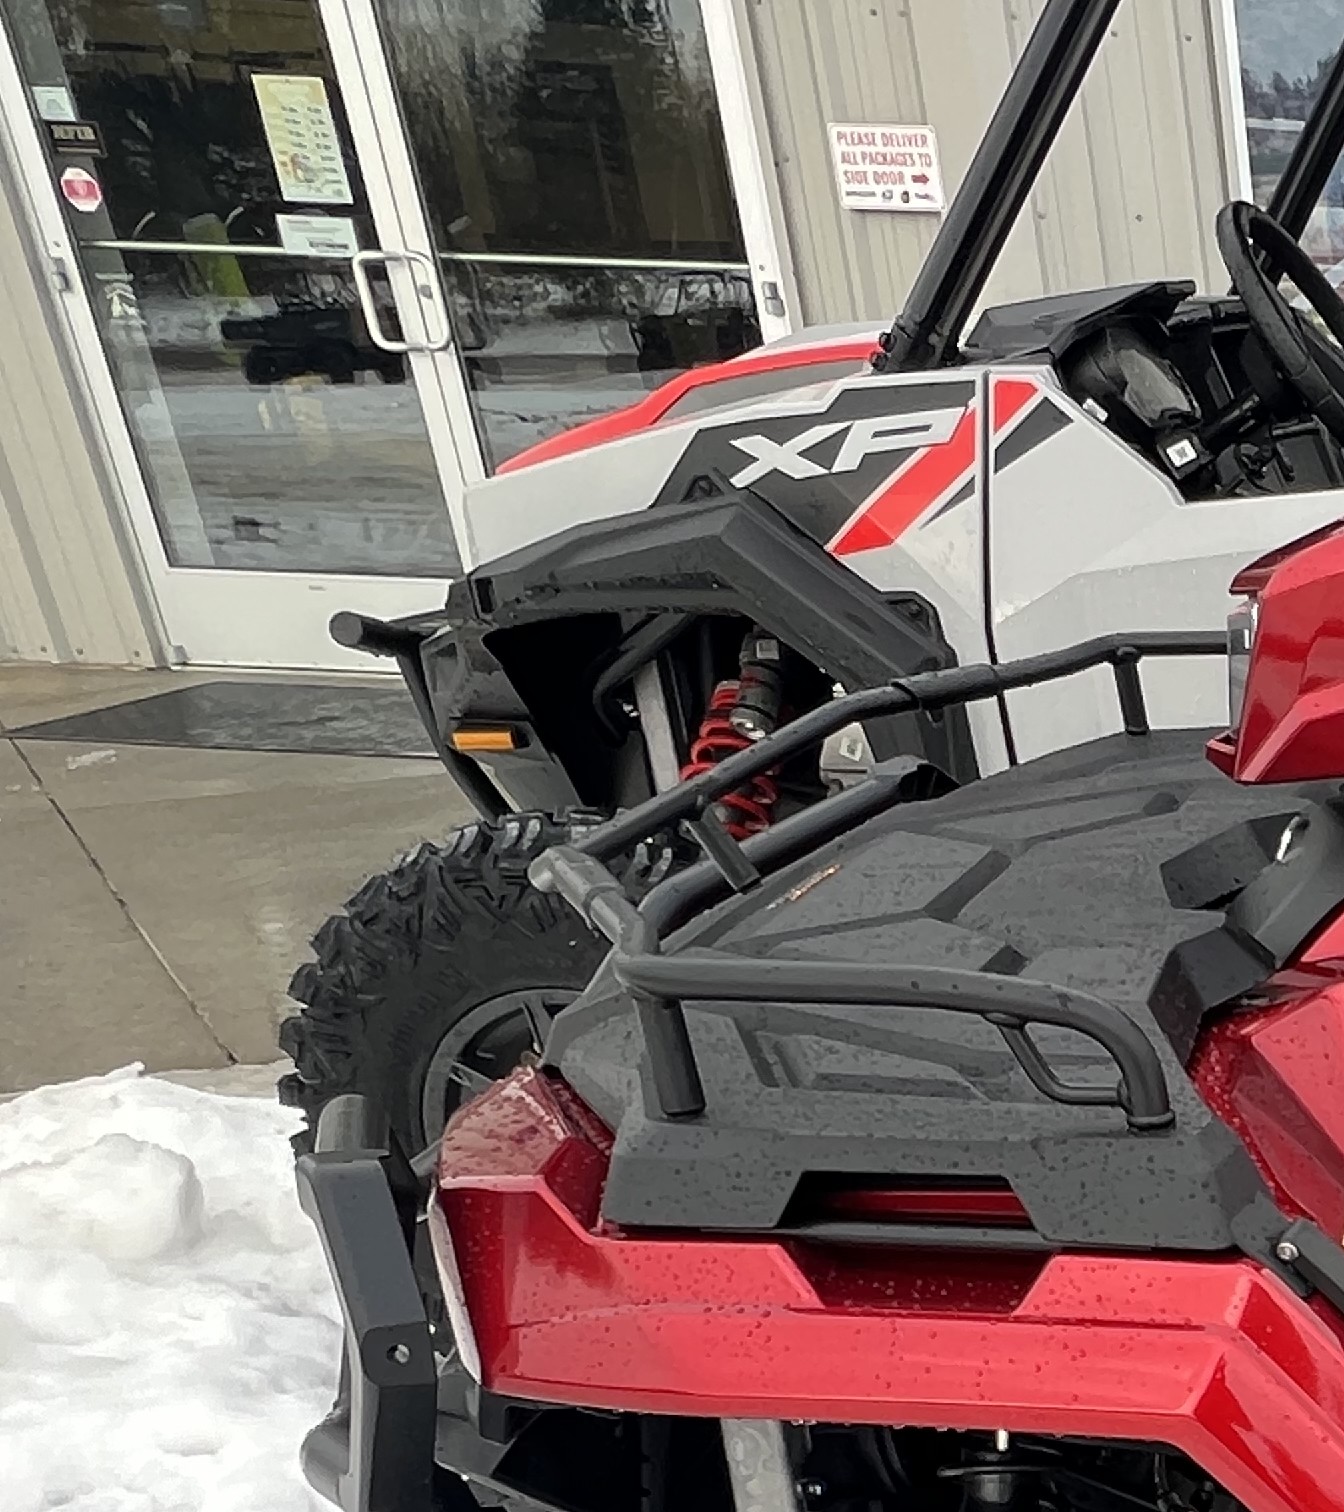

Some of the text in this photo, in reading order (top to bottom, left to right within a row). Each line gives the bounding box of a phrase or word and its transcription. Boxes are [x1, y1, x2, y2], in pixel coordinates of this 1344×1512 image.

[836, 131, 928, 147] PLEASE DELIVER
[841, 151, 932, 167] ALL PACKAGES TO
[843, 170, 905, 185] SIDE DOOR
[729, 406, 967, 489] XP
